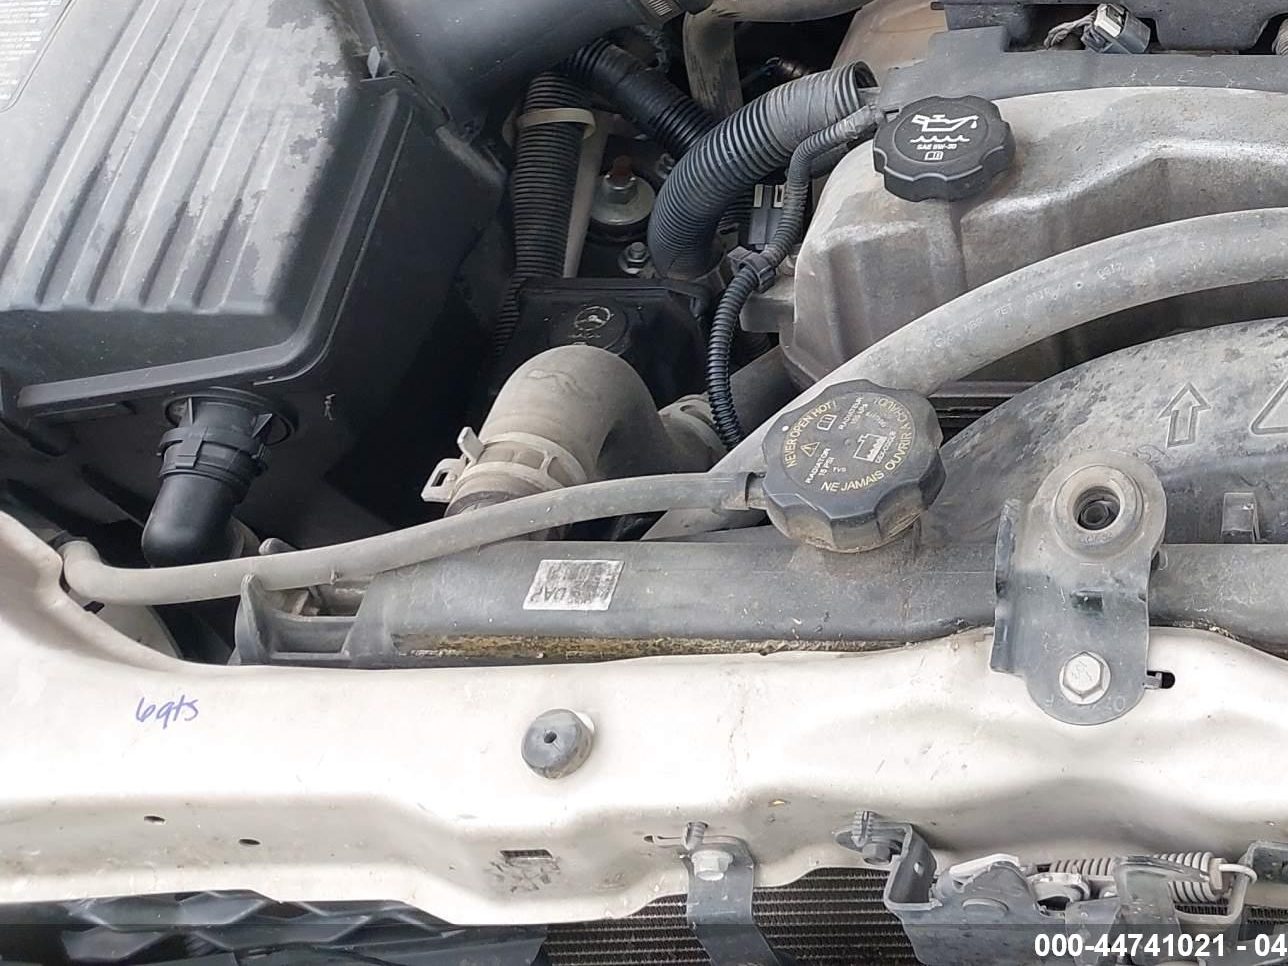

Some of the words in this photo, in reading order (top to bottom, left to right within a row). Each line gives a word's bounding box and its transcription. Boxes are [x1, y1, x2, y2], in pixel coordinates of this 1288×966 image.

[789, 413, 815, 438] OPEN
[784, 438, 798, 468] NEVER
[820, 481, 841, 493] NE
[840, 470, 885, 492] JAMAIS
[885, 432, 913, 471] OUVRIR
